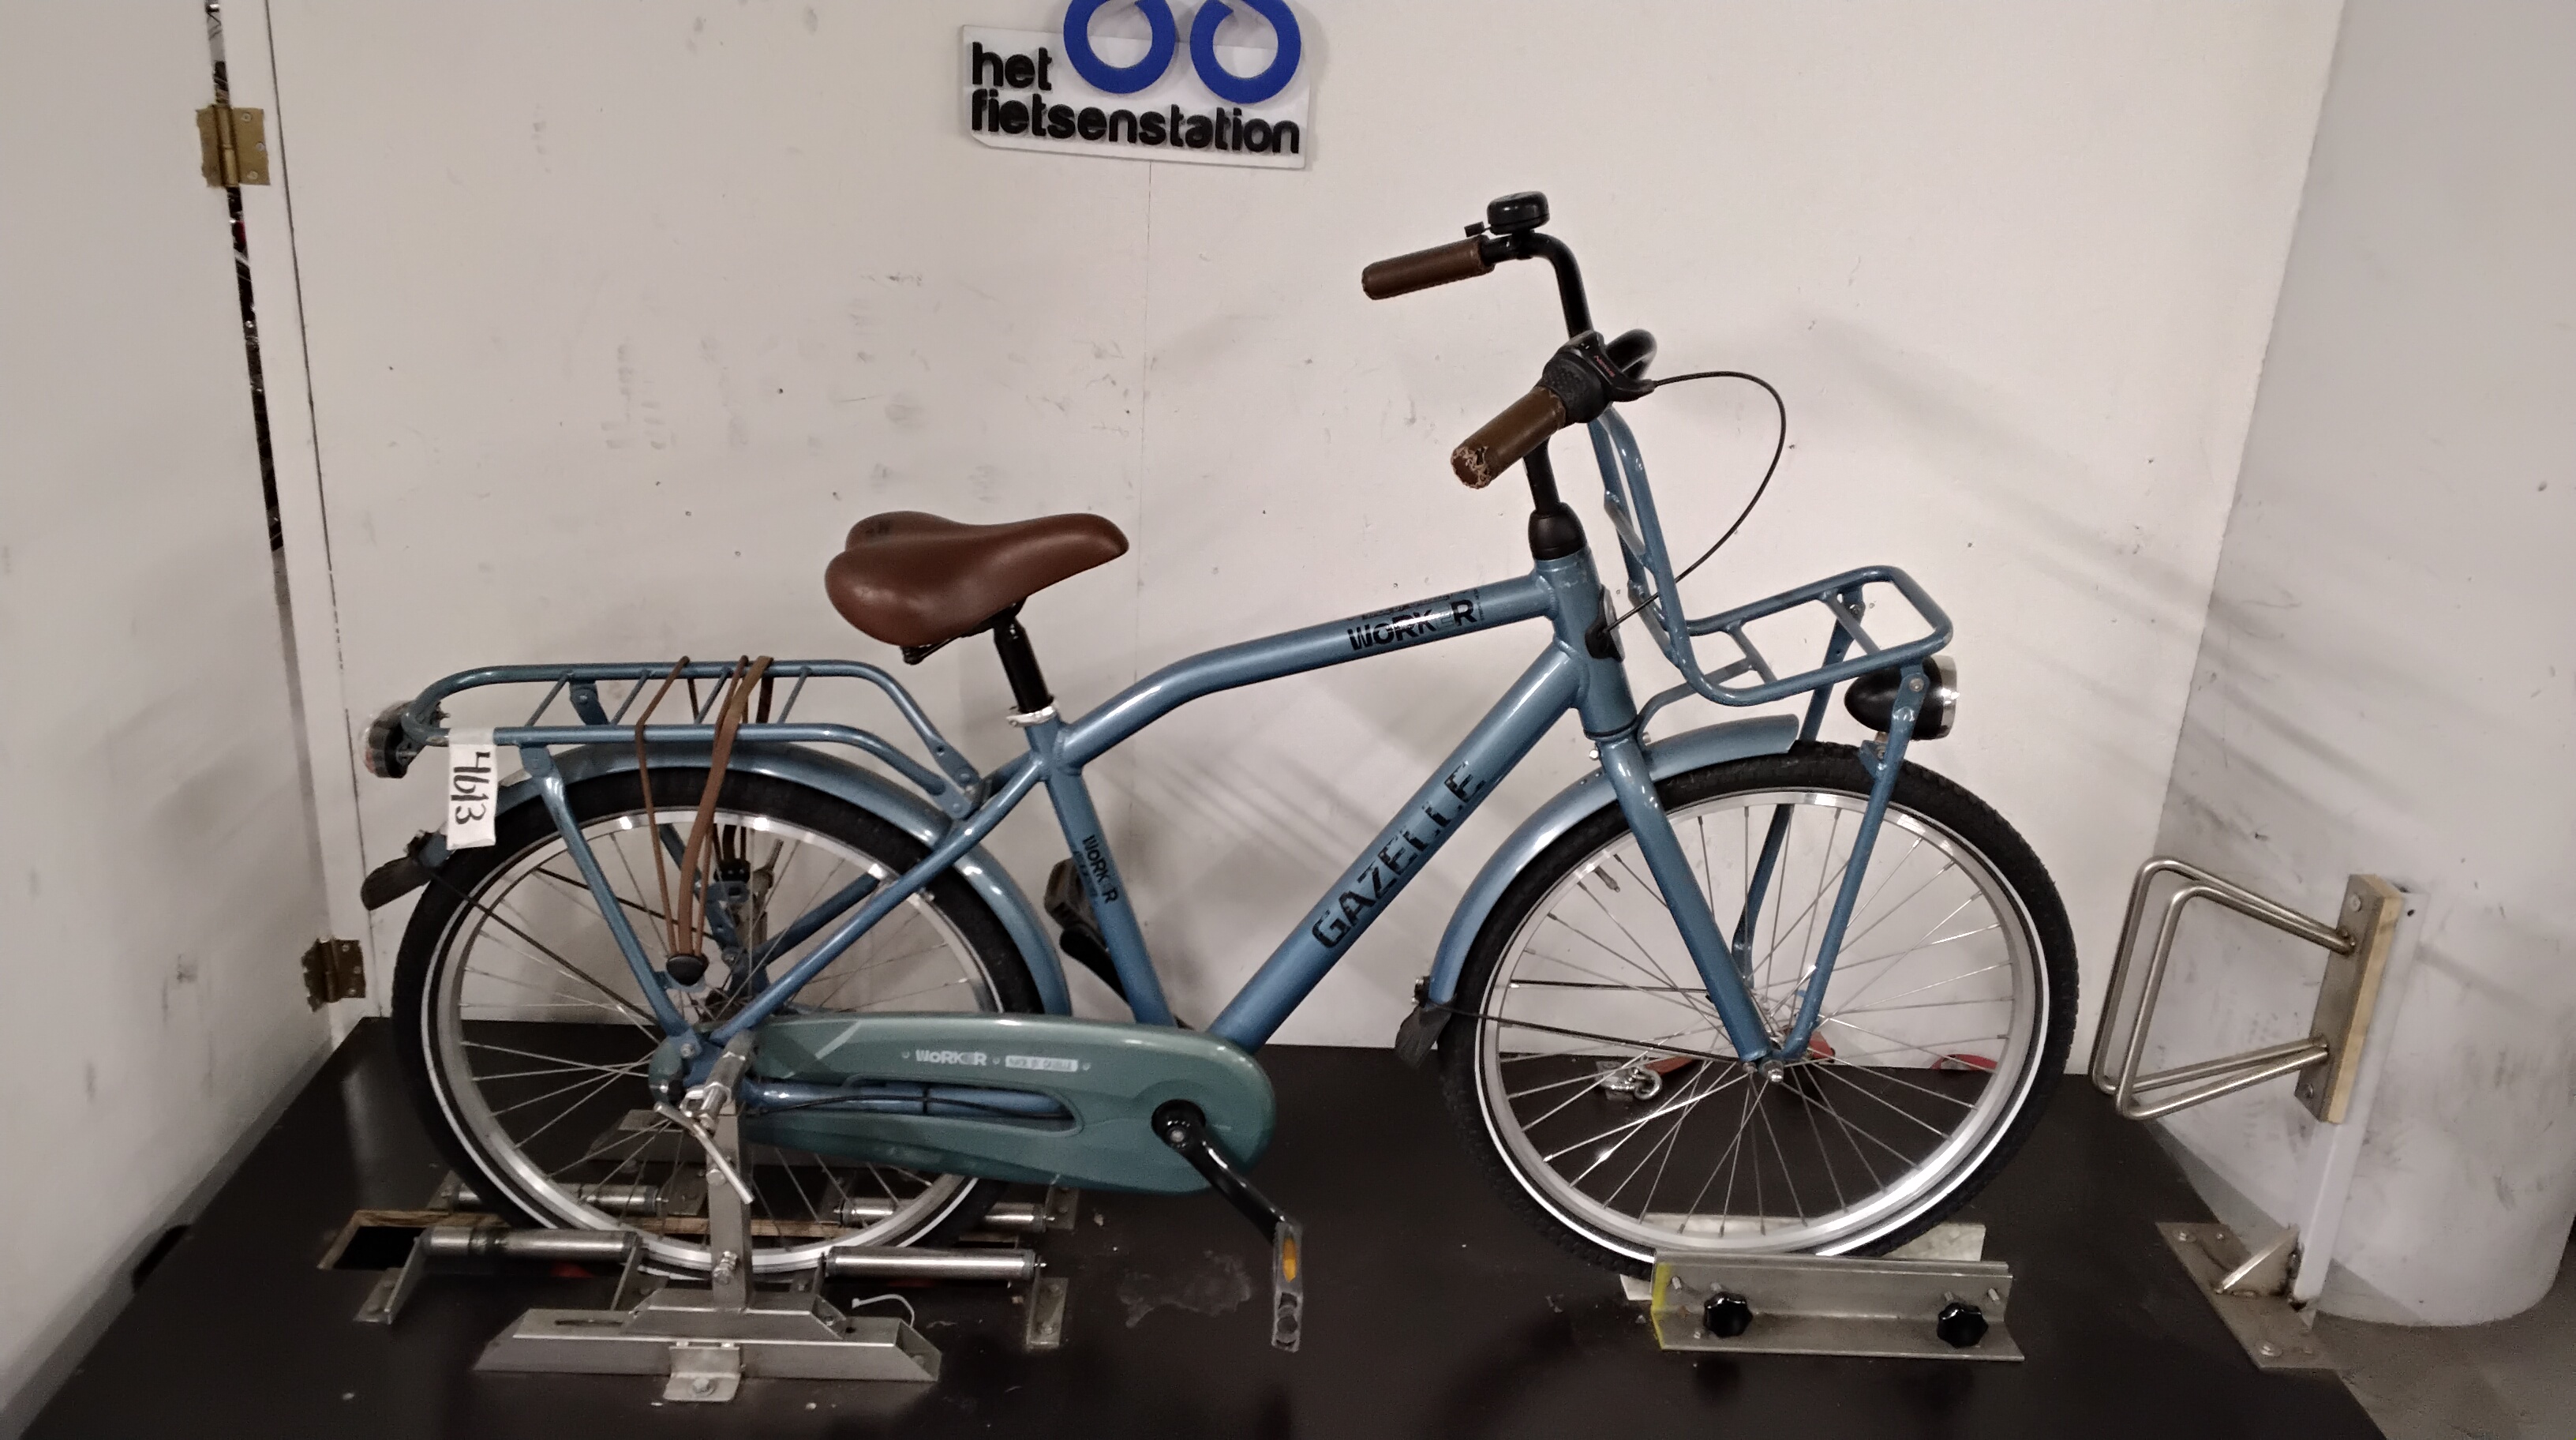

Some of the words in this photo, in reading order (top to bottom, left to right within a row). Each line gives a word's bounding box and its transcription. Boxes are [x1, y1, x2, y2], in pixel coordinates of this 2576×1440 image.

[972, 41, 1052, 91] het
[972, 88, 1300, 155] fietsenstation
[1347, 598, 1478, 651] WORKR
[450, 751, 492, 825] 4613
[1082, 834, 1118, 904] WORKR
